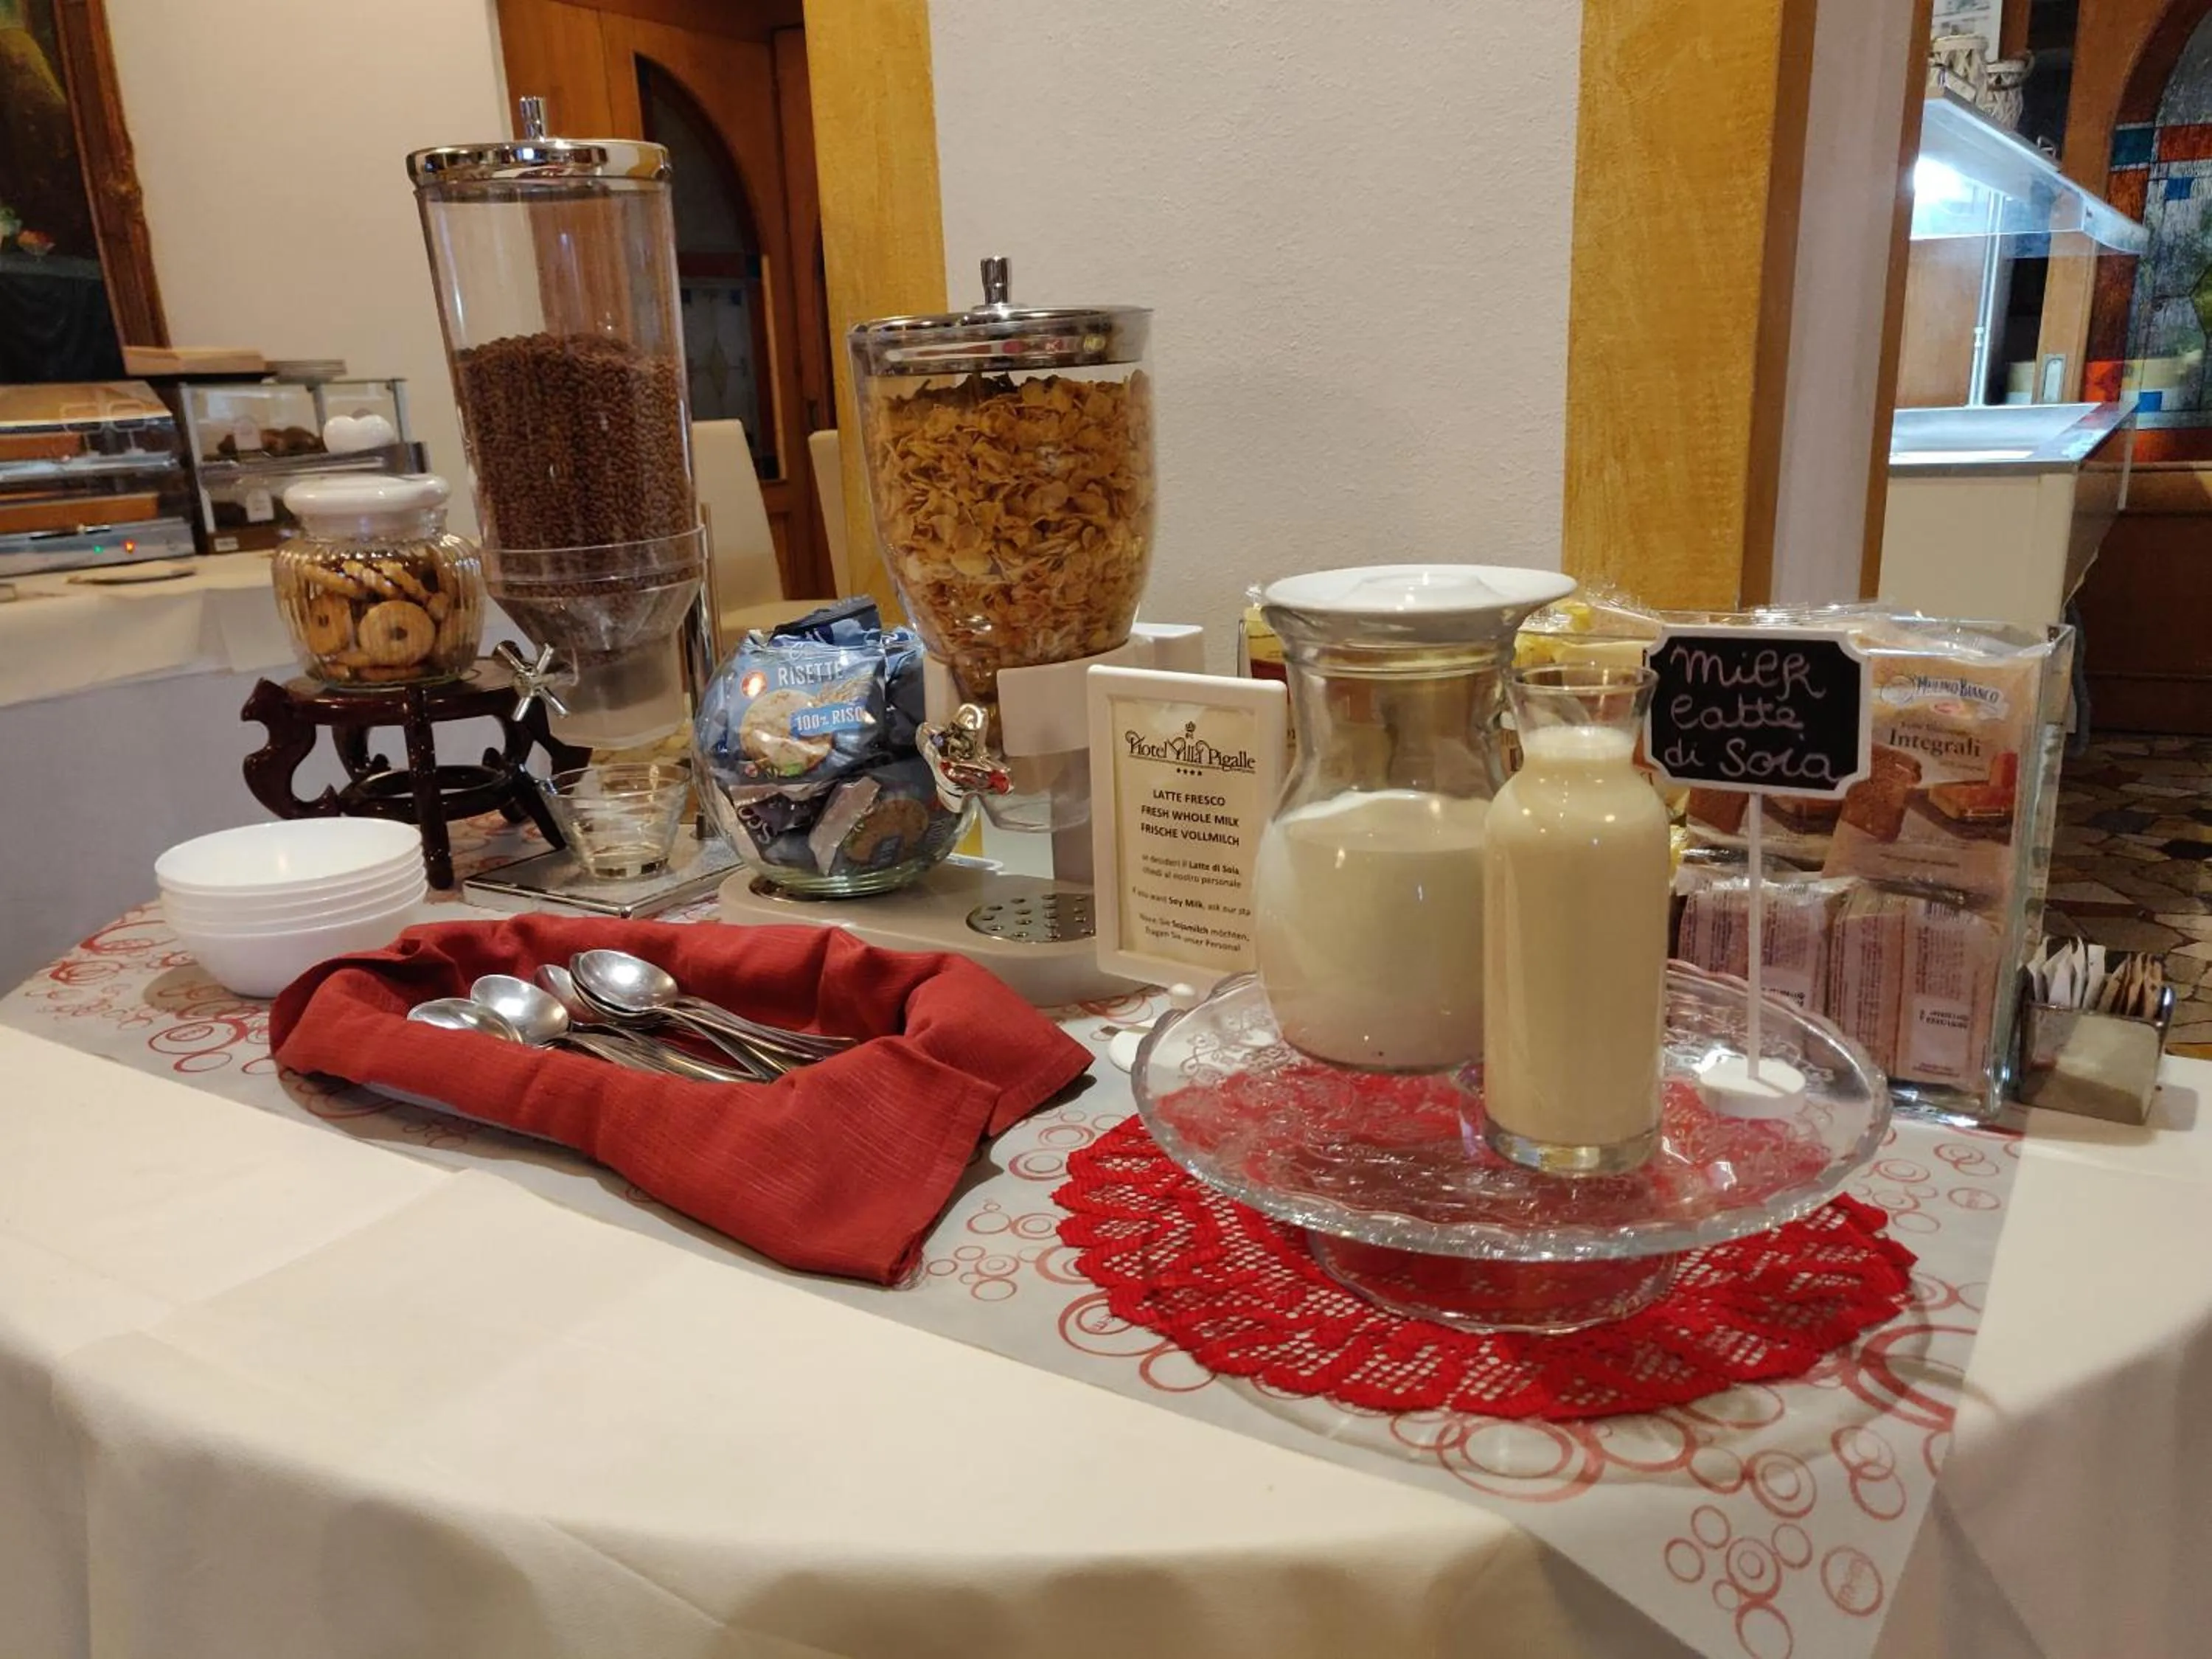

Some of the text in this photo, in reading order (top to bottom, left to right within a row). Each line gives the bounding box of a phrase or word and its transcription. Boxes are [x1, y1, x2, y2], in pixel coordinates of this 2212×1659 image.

[778, 660, 844, 686] RISETTE
[795, 706, 863, 731] 100% RISO
[1125, 730, 1256, 772] Hotel Villa Pigalle
[1889, 728, 1981, 757] Integrali
[1664, 733, 1843, 782] di Soia
[1153, 790, 1225, 806] LATTE FRESCO
[1141, 804, 1239, 827] FRESH WHOLE MILK
[1141, 822, 1239, 847] FRISCHE VOLLMILCH
[1189, 860, 1210, 871] Latte
[1211, 863, 1220, 872] di
[1222, 865, 1239, 875] Soia
[1201, 876, 1242, 888] personale
[1169, 897, 1183, 907] Soy
